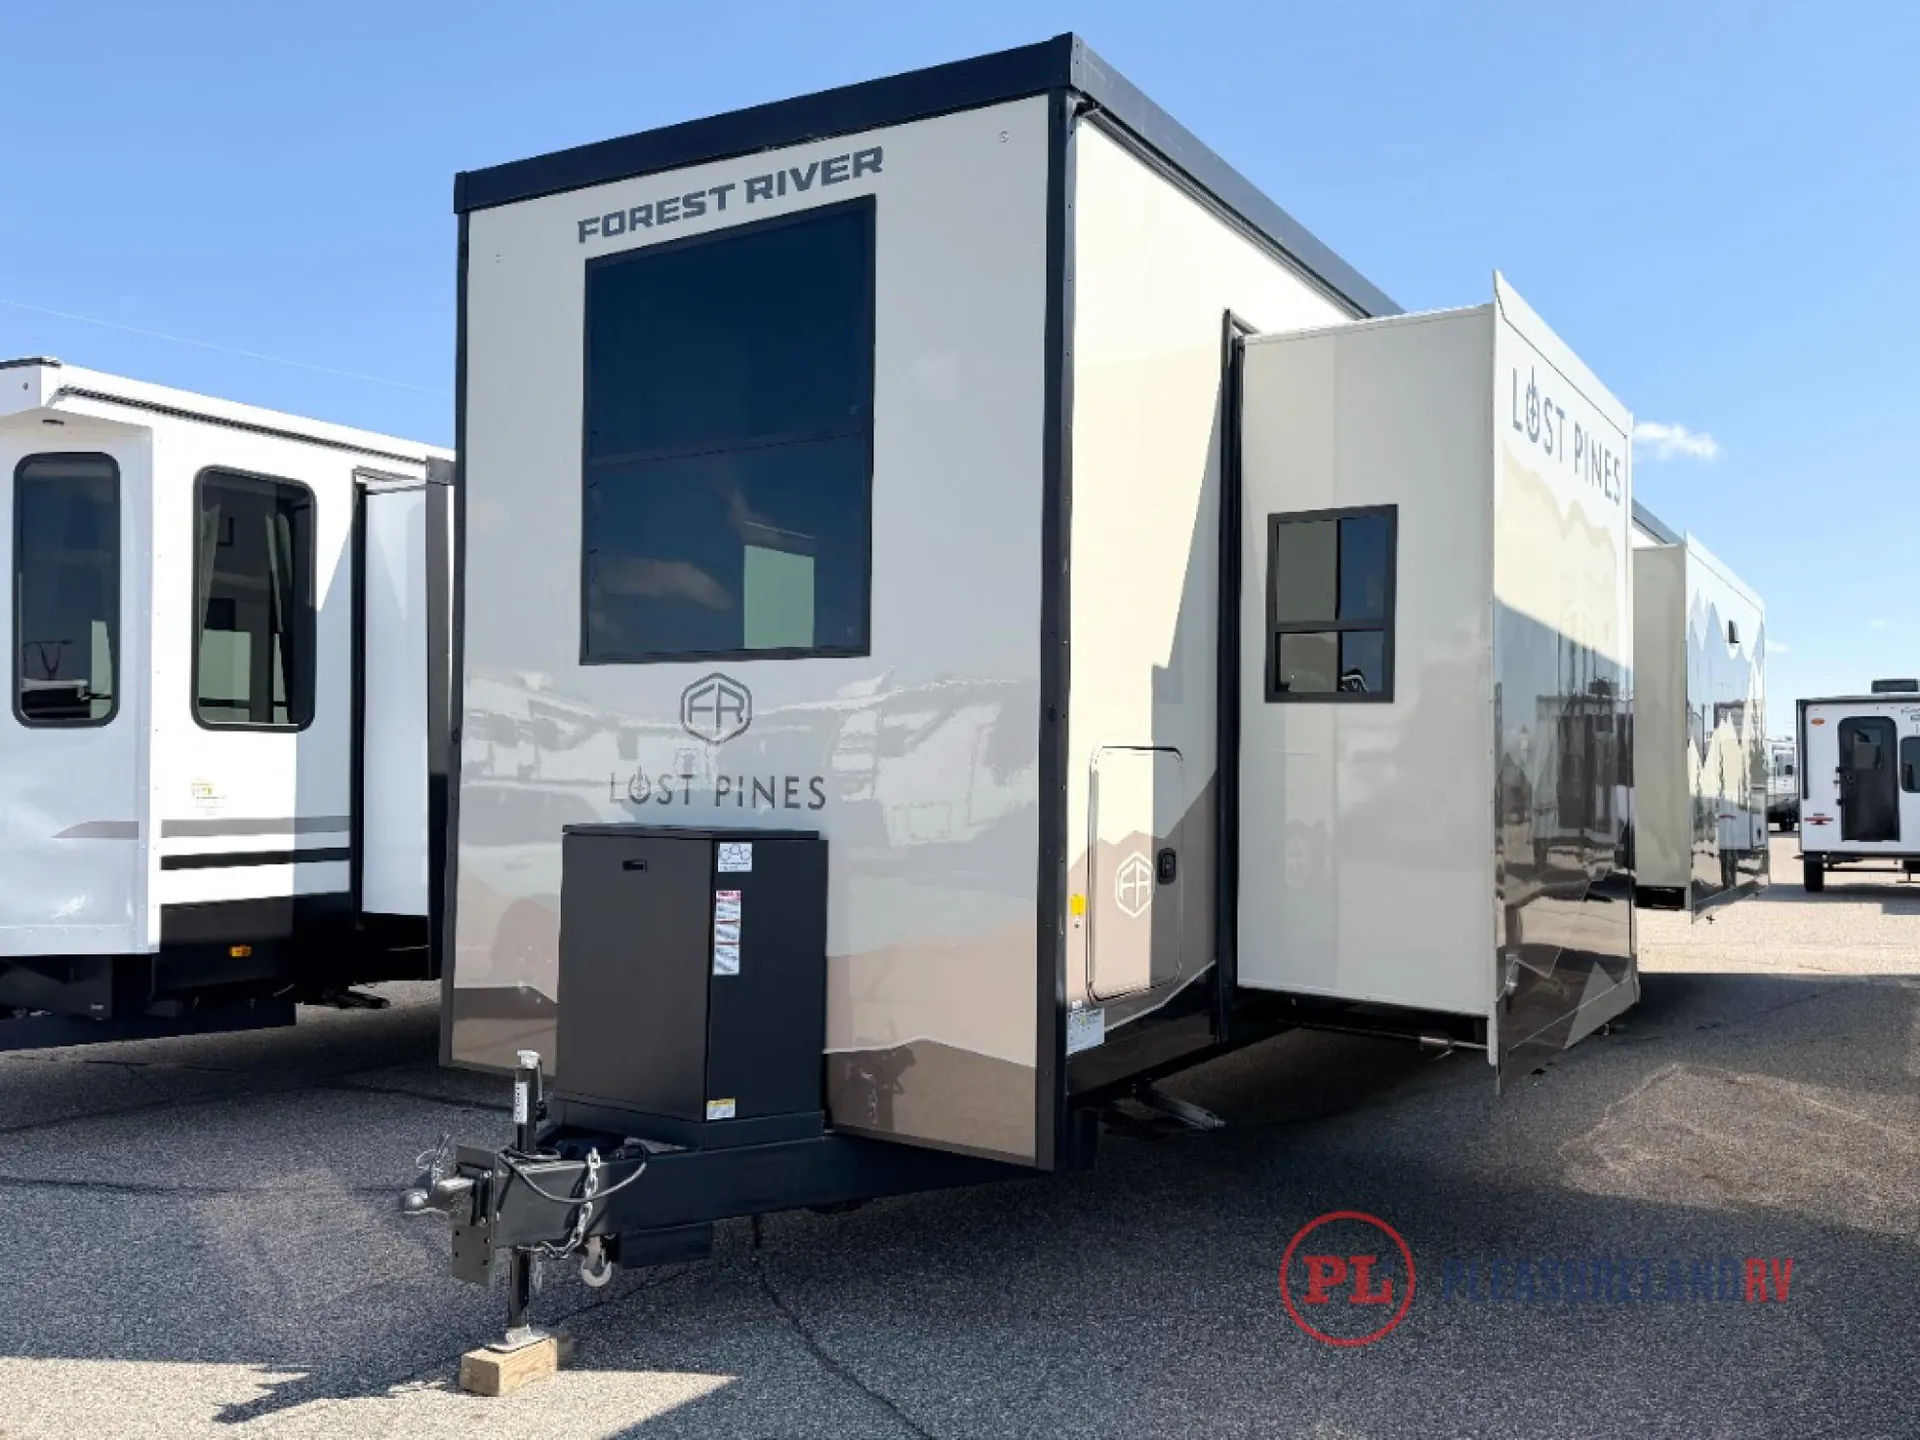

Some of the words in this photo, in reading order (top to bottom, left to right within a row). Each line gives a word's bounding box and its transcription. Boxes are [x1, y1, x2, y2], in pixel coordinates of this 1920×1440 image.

[577, 183, 736, 244] FOREST
[744, 146, 884, 203] RIVER
[1512, 363, 1567, 464] LOST
[1574, 420, 1621, 507] PINES
[609, 766, 694, 806] LOST
[714, 774, 827, 811] PINES
